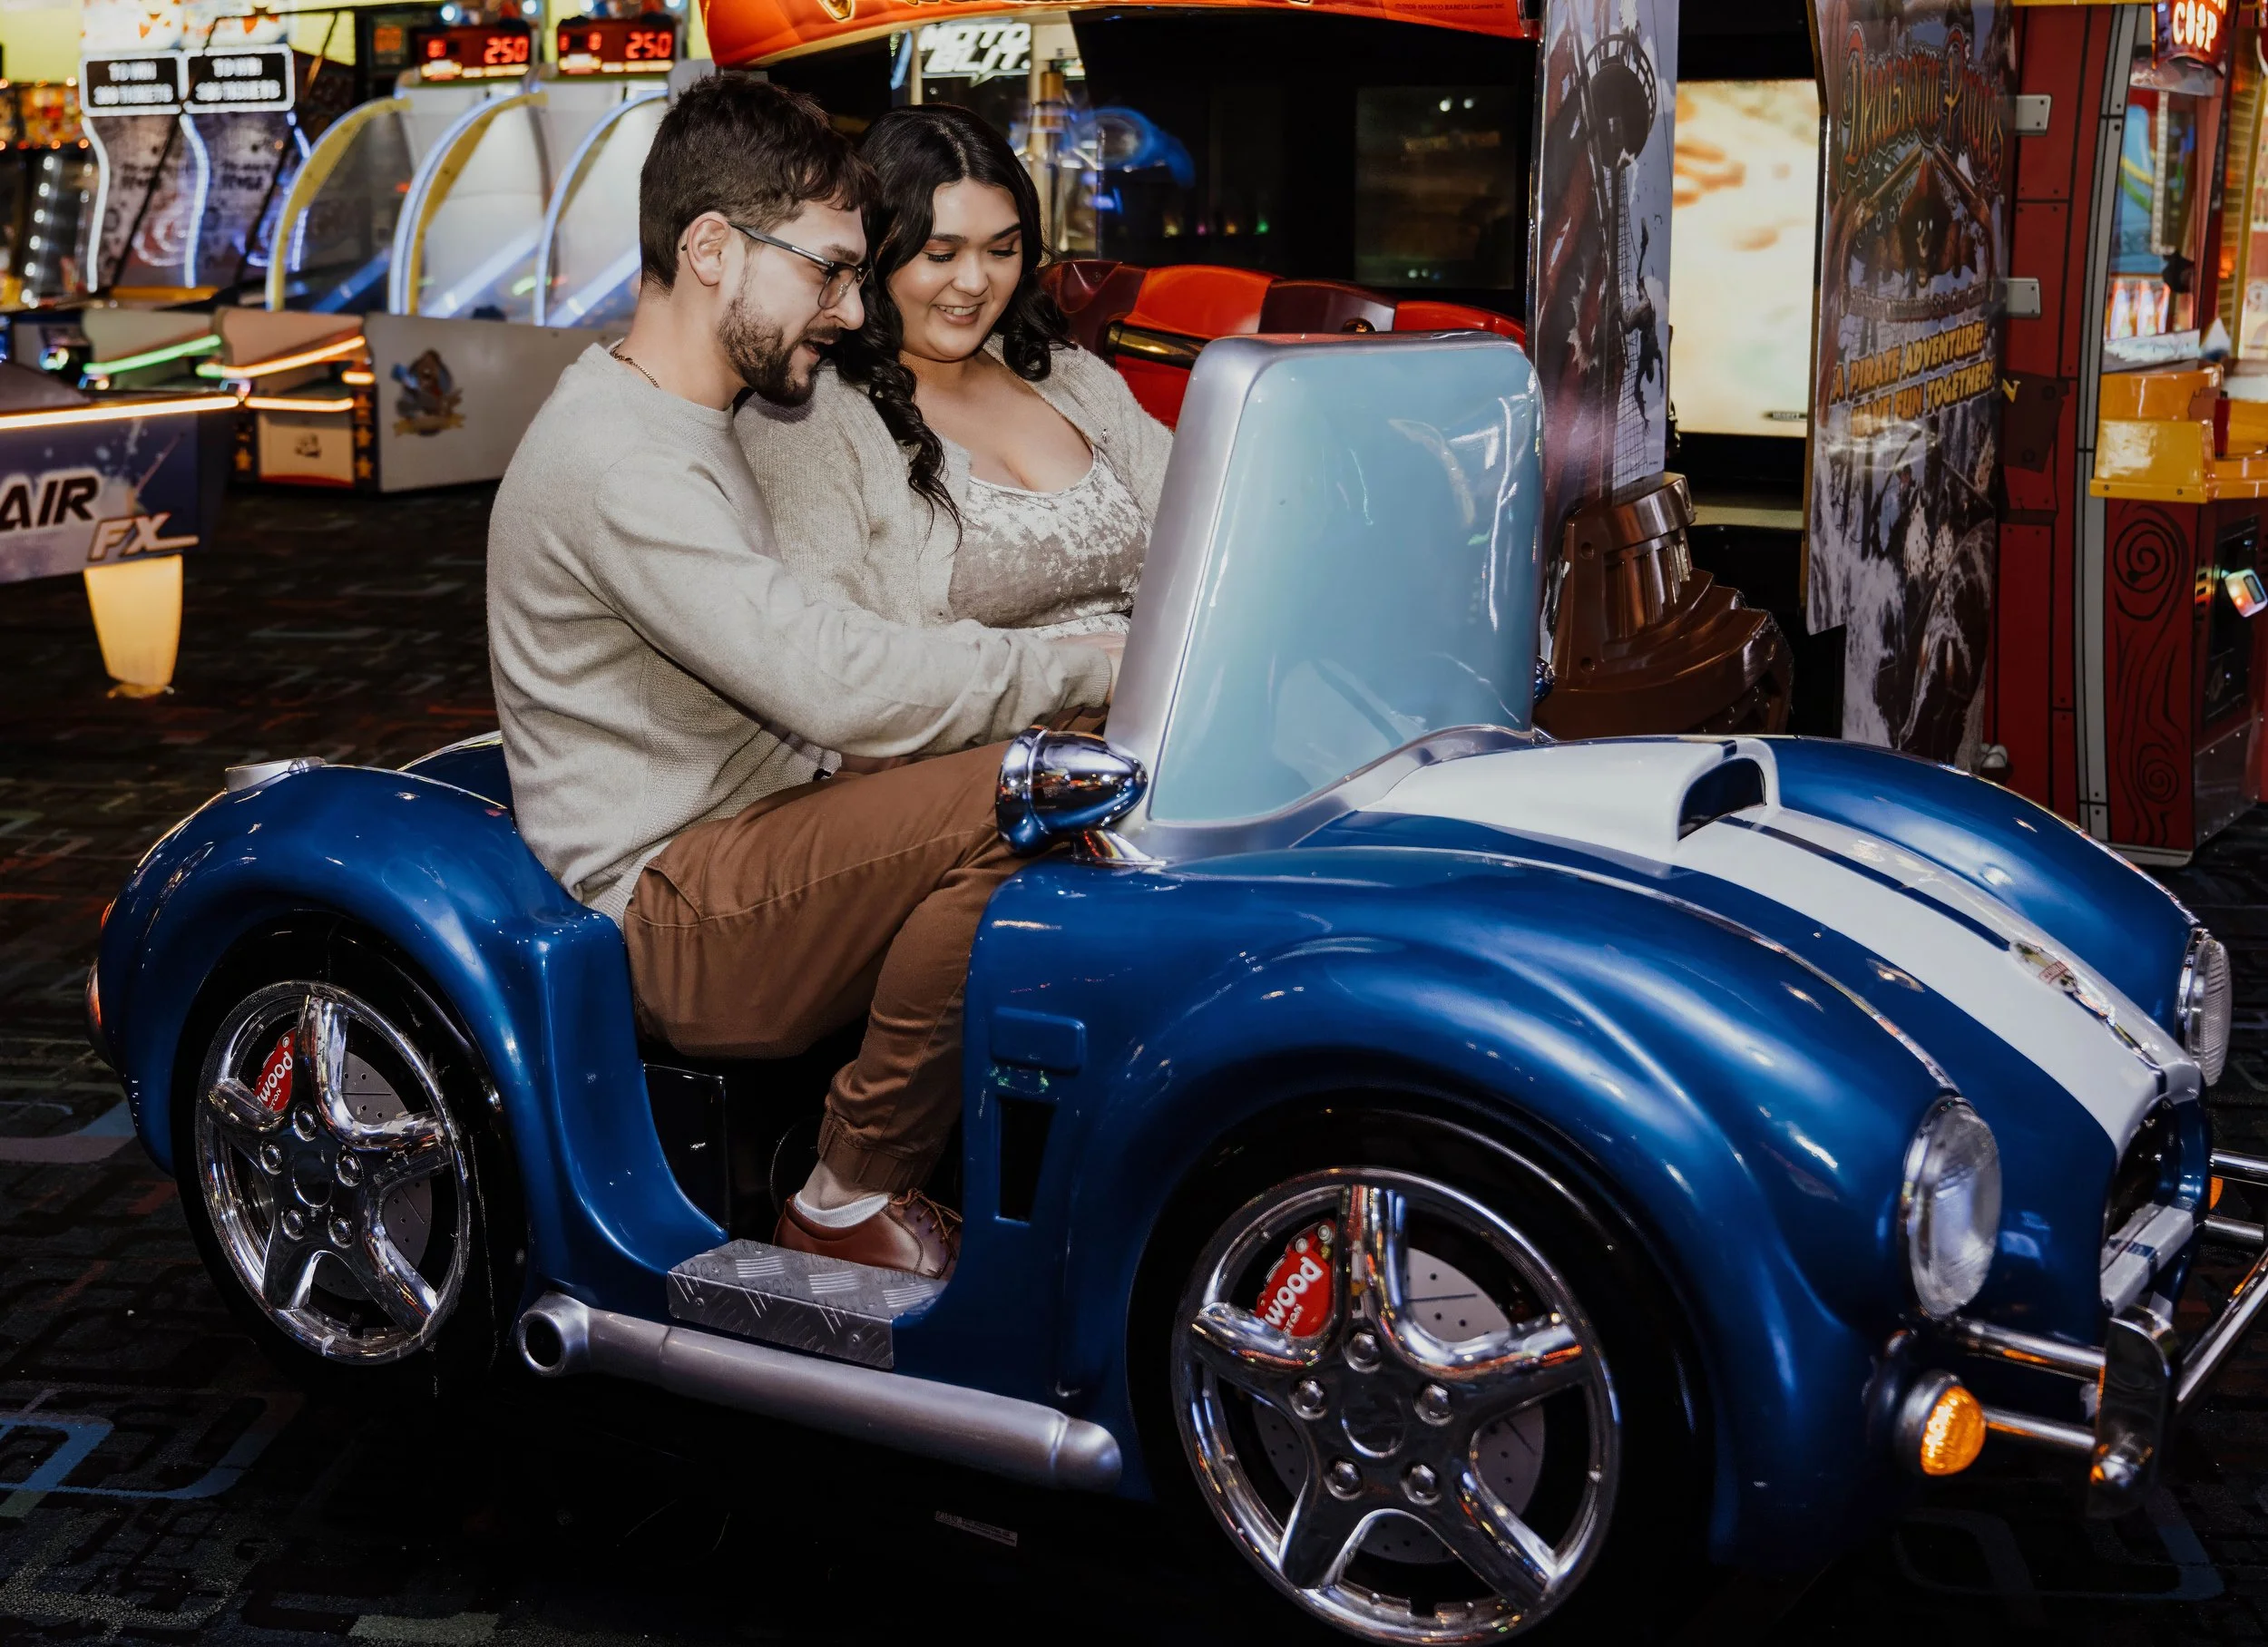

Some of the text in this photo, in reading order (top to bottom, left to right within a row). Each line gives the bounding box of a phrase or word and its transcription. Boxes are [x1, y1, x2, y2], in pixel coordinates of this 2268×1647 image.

[484, 35, 530, 64] 250
[625, 31, 674, 60] 250
[918, 23, 1031, 52] MOTO
[1831, 319, 1986, 400] A PIRATE ADVENTURE!
[1894, 385, 1924, 420] FUN
[1926, 361, 1995, 409] TOGETHER!
[0, 475, 200, 562] AIR FX
[1261, 1255, 1325, 1327] wood
